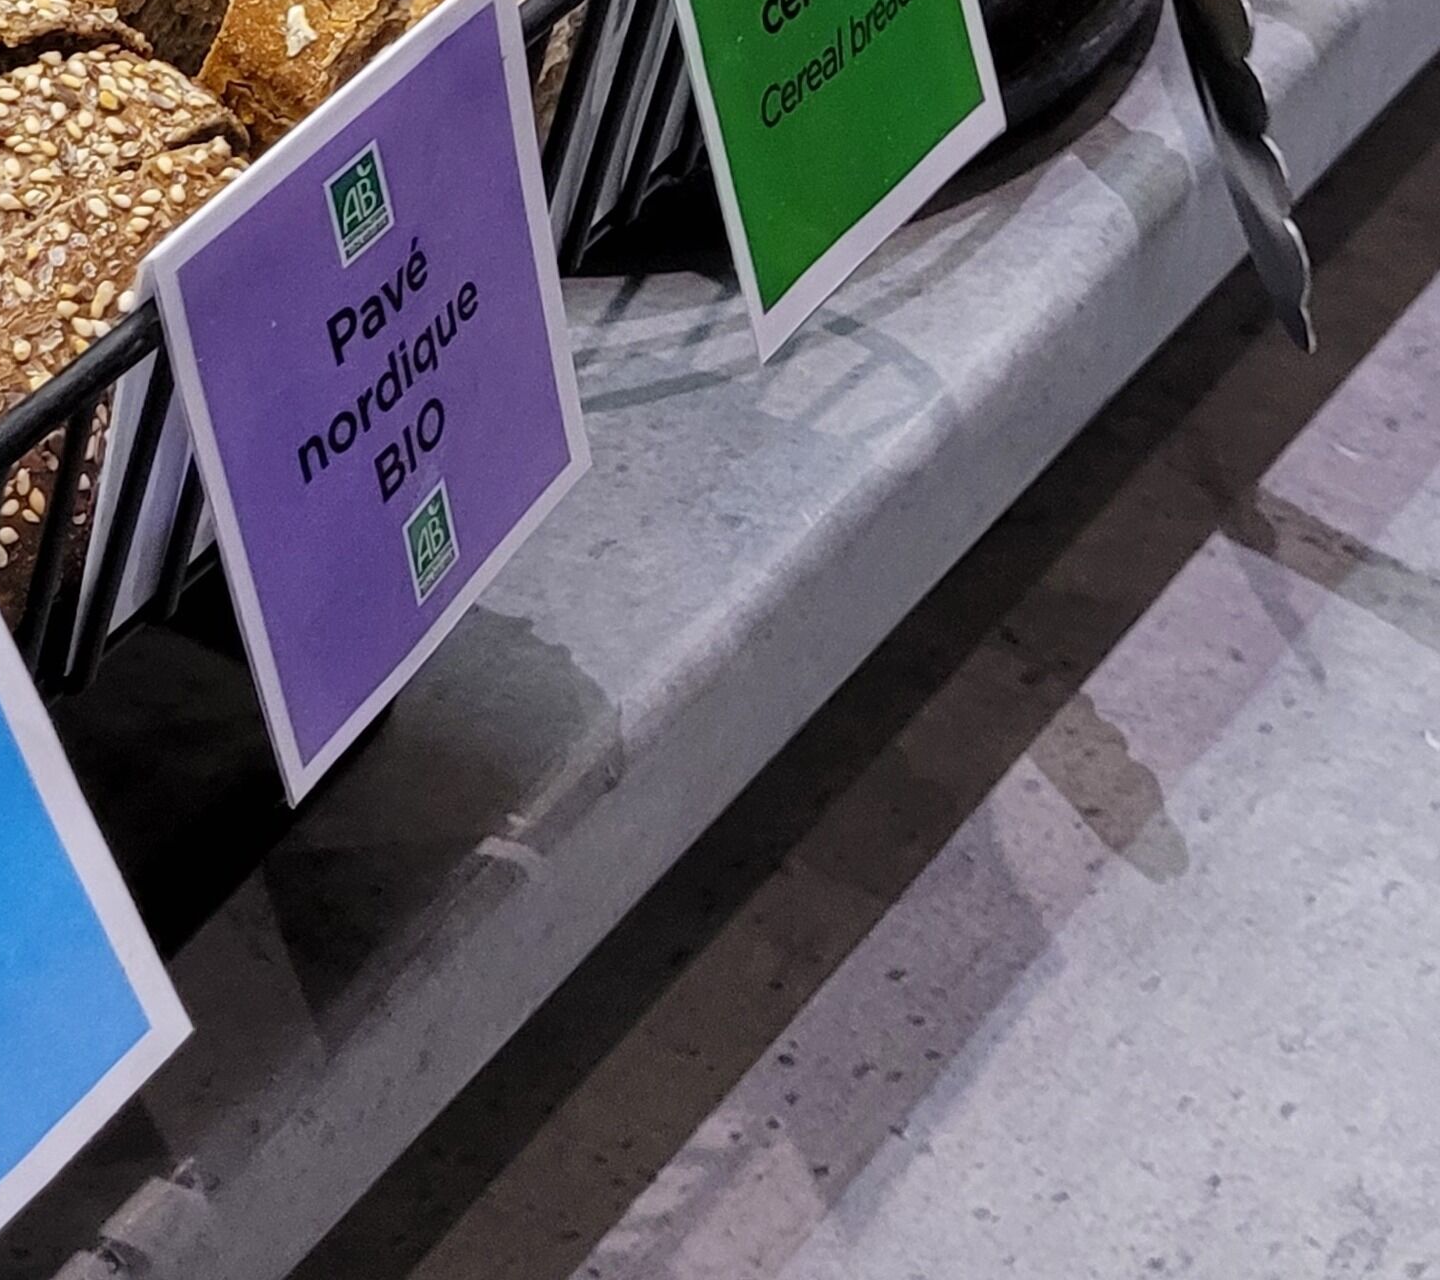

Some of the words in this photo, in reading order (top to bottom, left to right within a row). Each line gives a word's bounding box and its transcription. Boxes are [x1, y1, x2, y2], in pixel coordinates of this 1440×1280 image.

[760, 23, 845, 129] Cereal
[343, 178, 376, 234] AB
[326, 237, 429, 366] Pavé
[297, 280, 479, 483] nordique
[374, 397, 445, 502] BIO
[418, 517, 445, 574] AB
